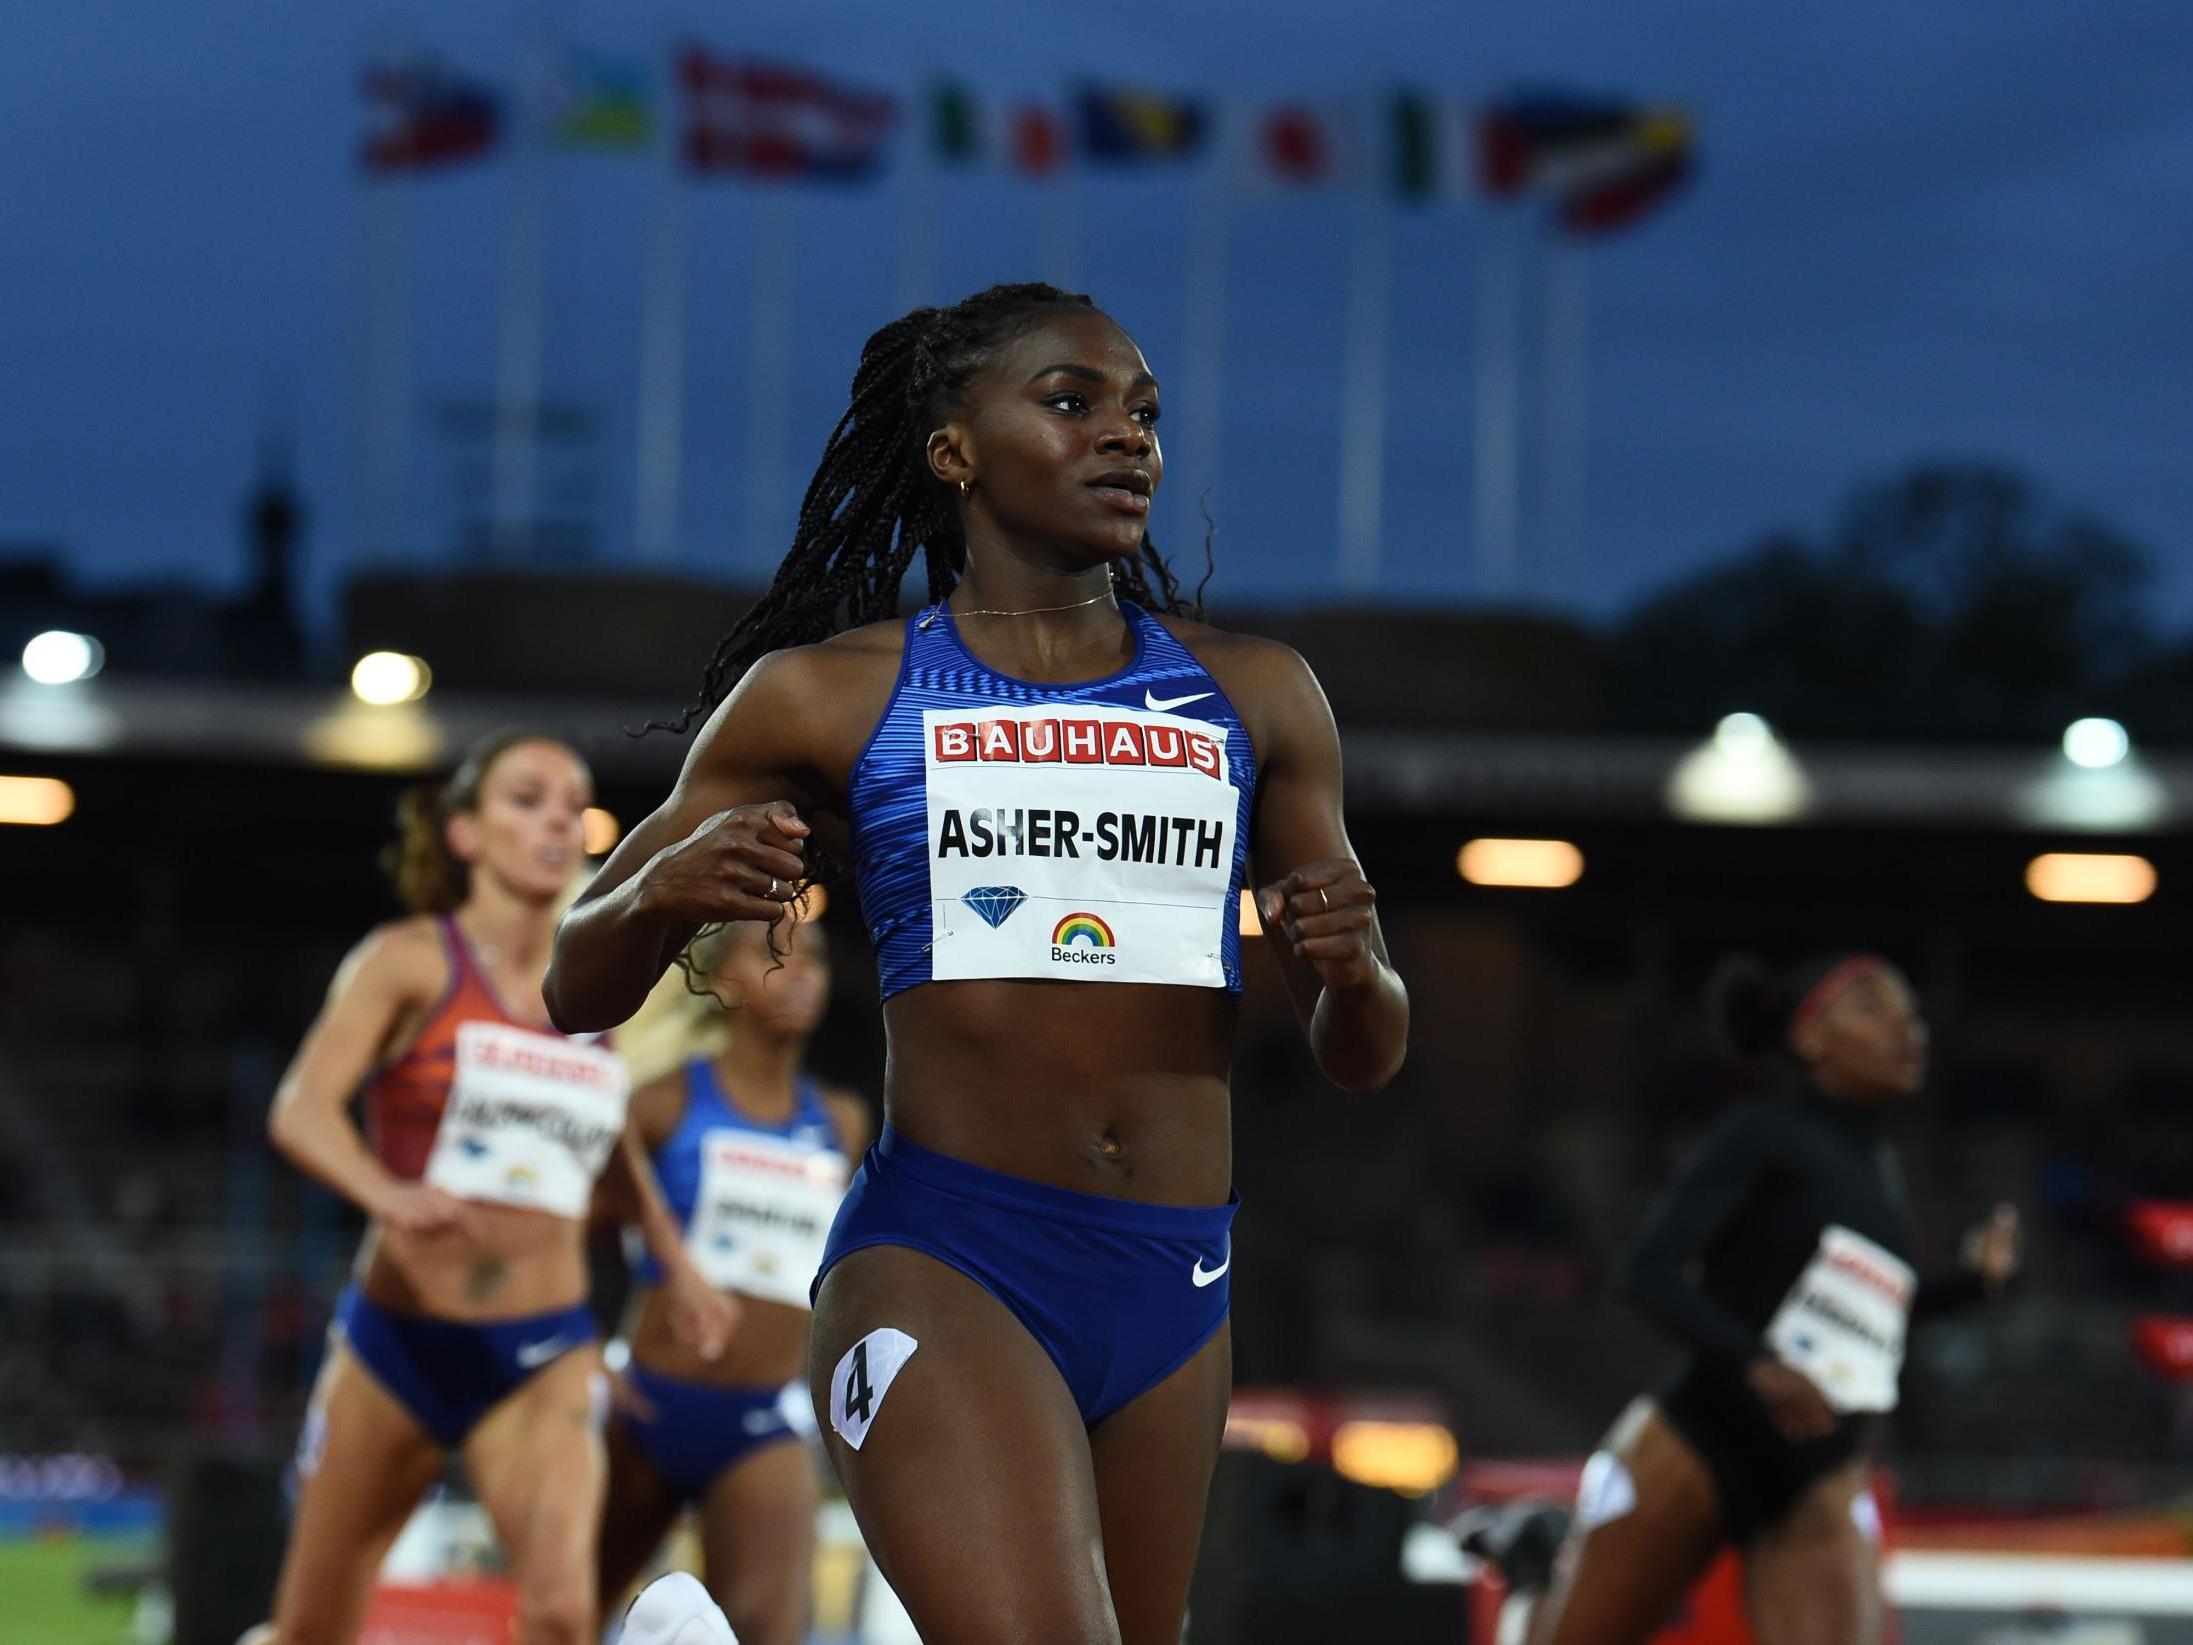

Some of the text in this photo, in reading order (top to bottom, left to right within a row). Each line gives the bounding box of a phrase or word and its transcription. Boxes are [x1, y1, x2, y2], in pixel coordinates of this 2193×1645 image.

[940, 723, 1216, 771] BAUHAUS
[938, 808, 1223, 868] ASHER-SMITH
[1051, 947, 1116, 965] Beckers
[845, 1341, 874, 1423] 4
